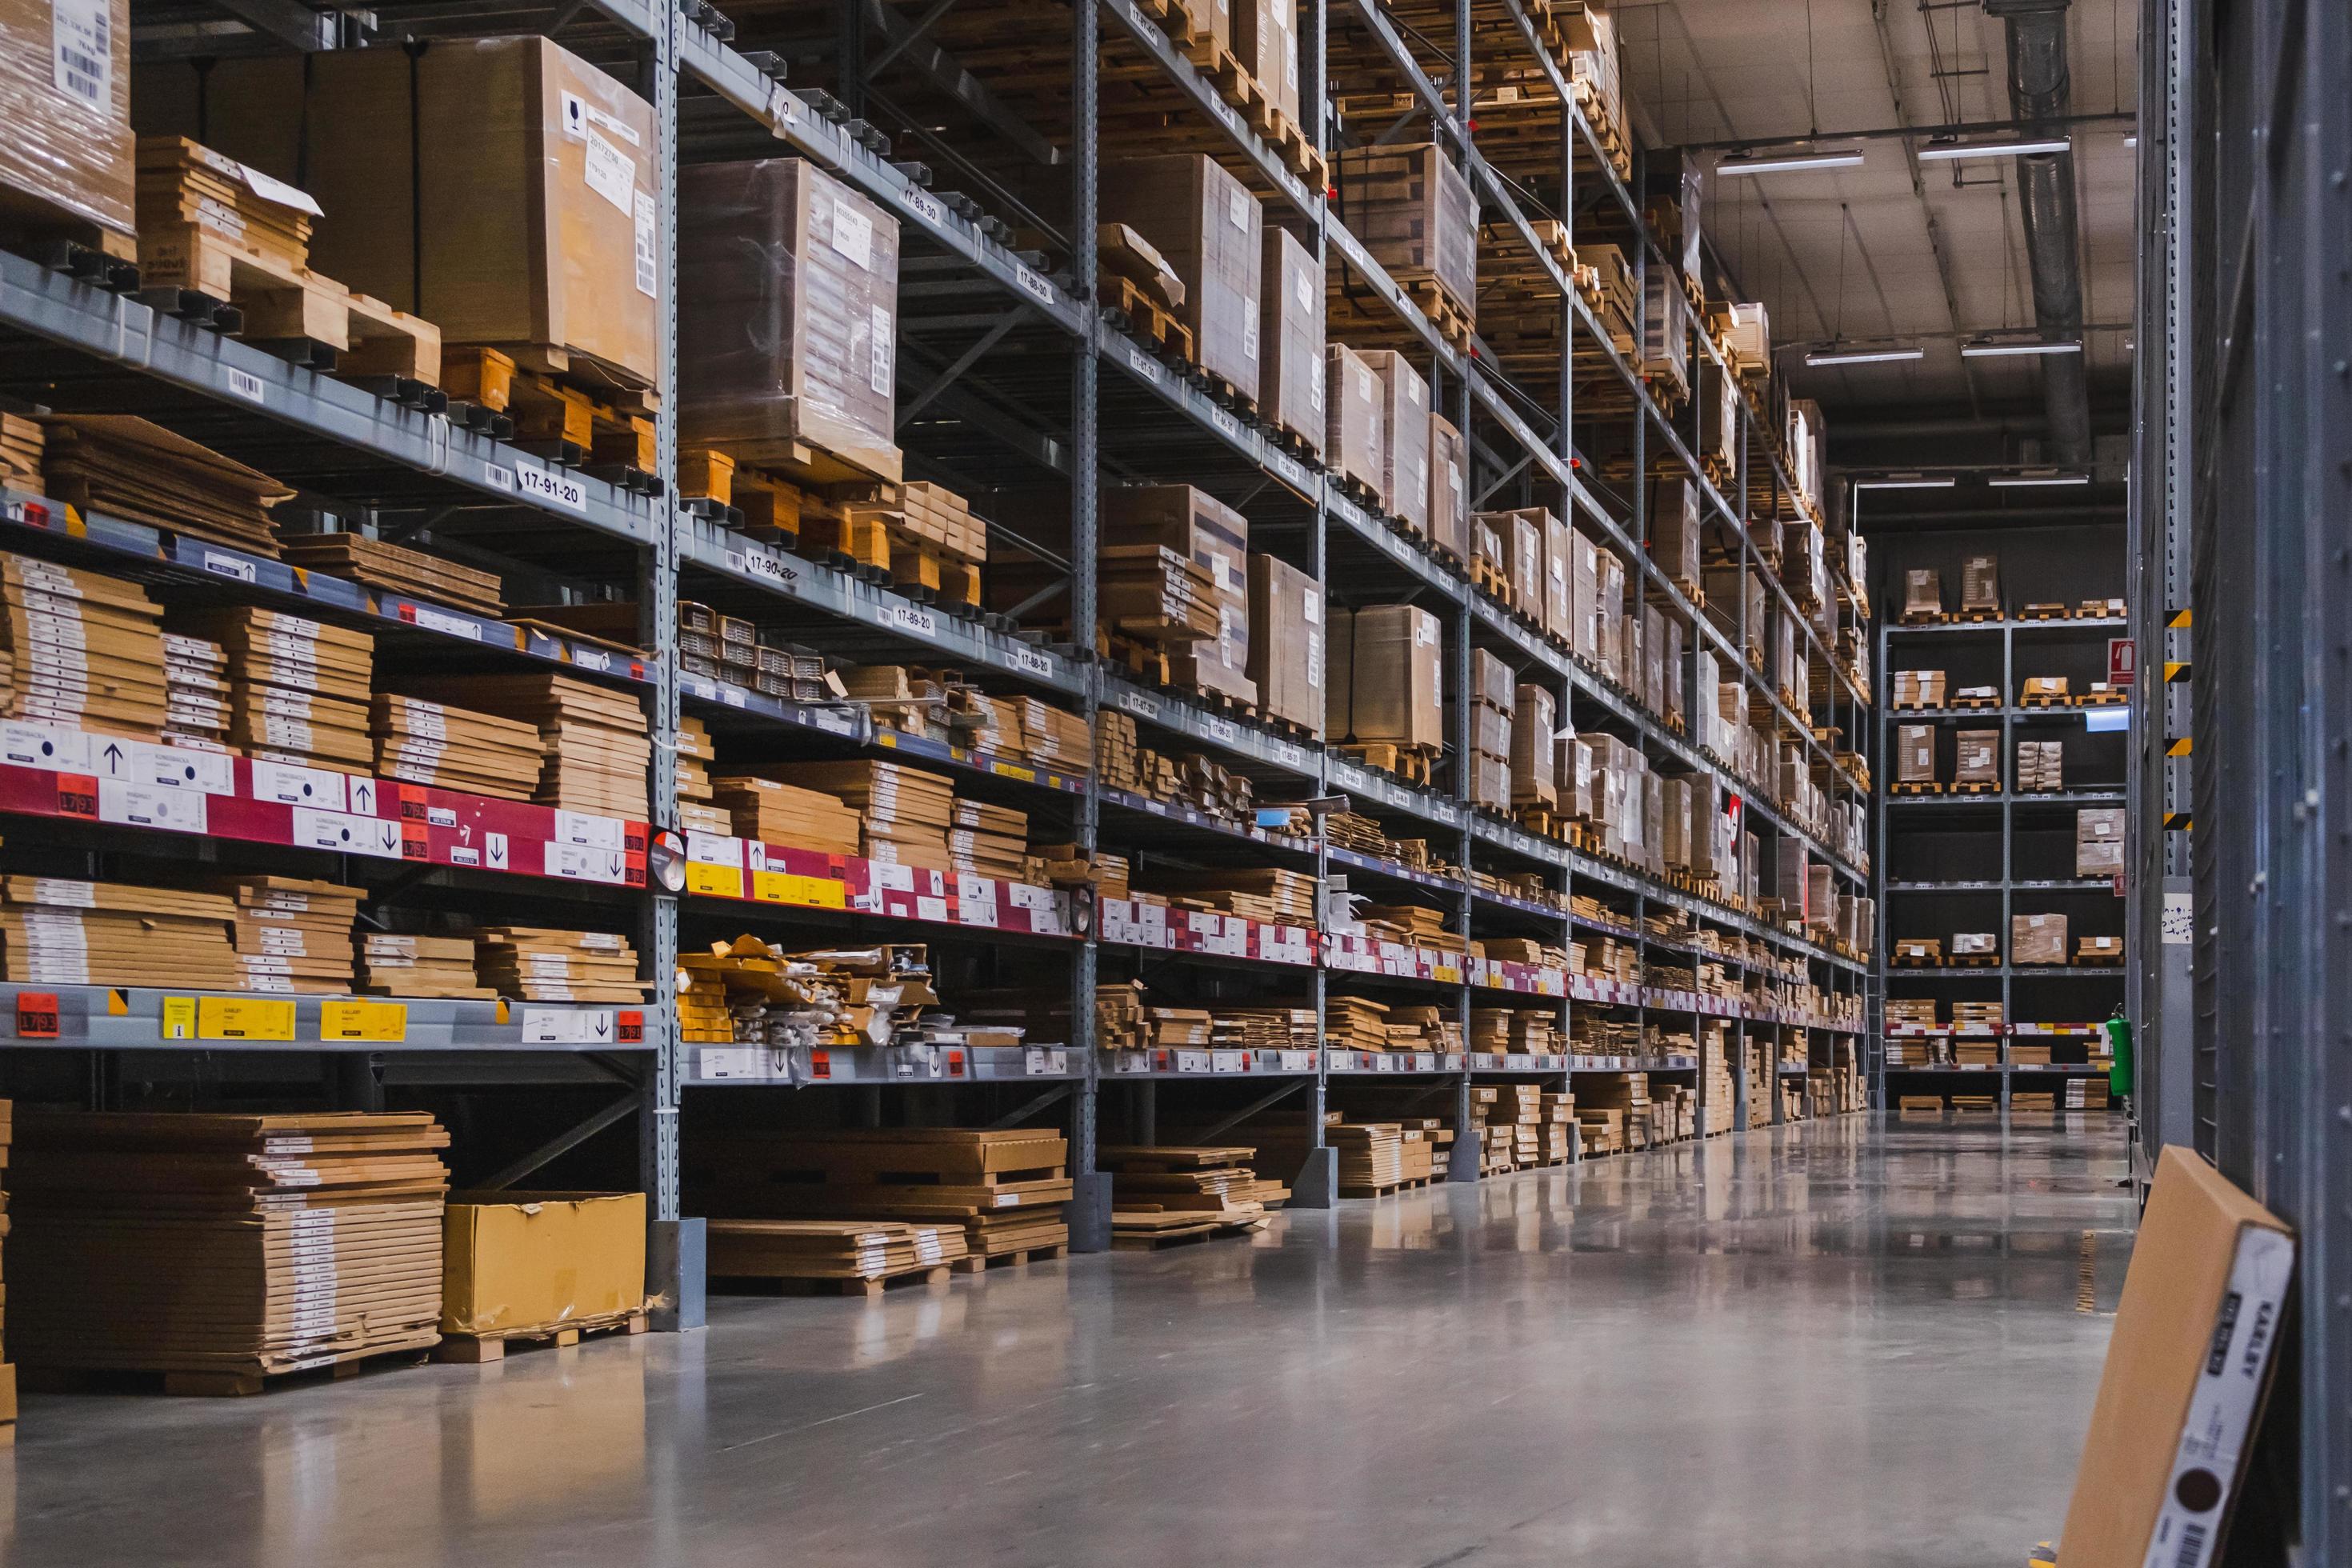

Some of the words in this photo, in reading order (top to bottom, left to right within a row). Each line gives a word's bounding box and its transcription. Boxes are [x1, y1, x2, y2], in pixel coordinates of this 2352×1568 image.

[904, 190, 936, 220] 17-89-30
[1020, 270, 1047, 297] 17-88-30
[524, 471, 578, 503] 17-91-20
[750, 555, 798, 580] 17-90-20
[898, 609, 930, 630] 17-89-20
[1021, 654, 1048, 673] 17-88-20
